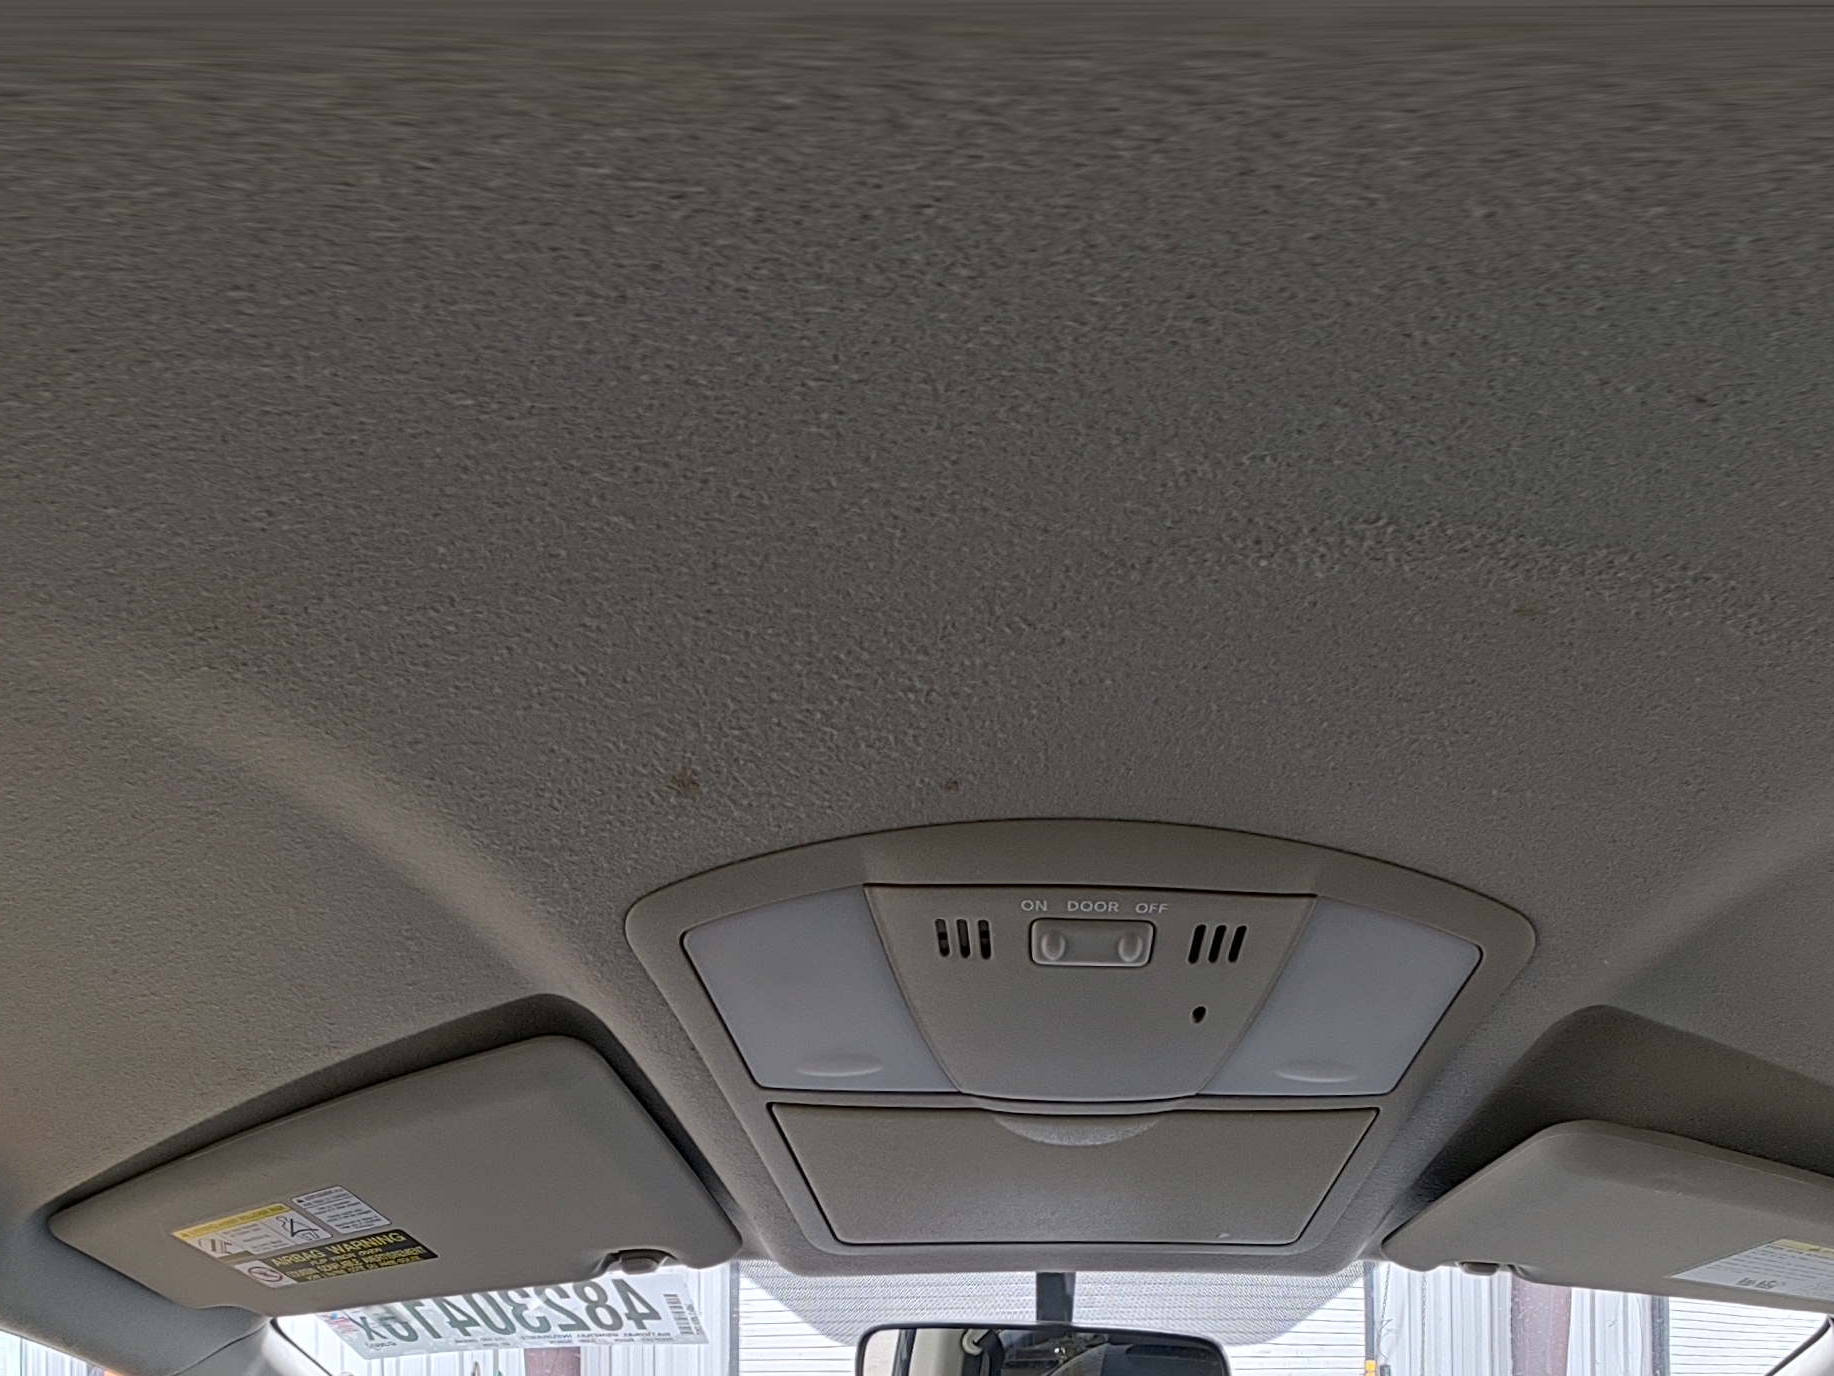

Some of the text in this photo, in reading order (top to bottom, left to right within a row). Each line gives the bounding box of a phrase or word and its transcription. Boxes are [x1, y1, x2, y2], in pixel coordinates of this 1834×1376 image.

[1020, 900, 1168, 914] ON DOOR OFF
[271, 1232, 407, 1267] AIRBAG WARNING
